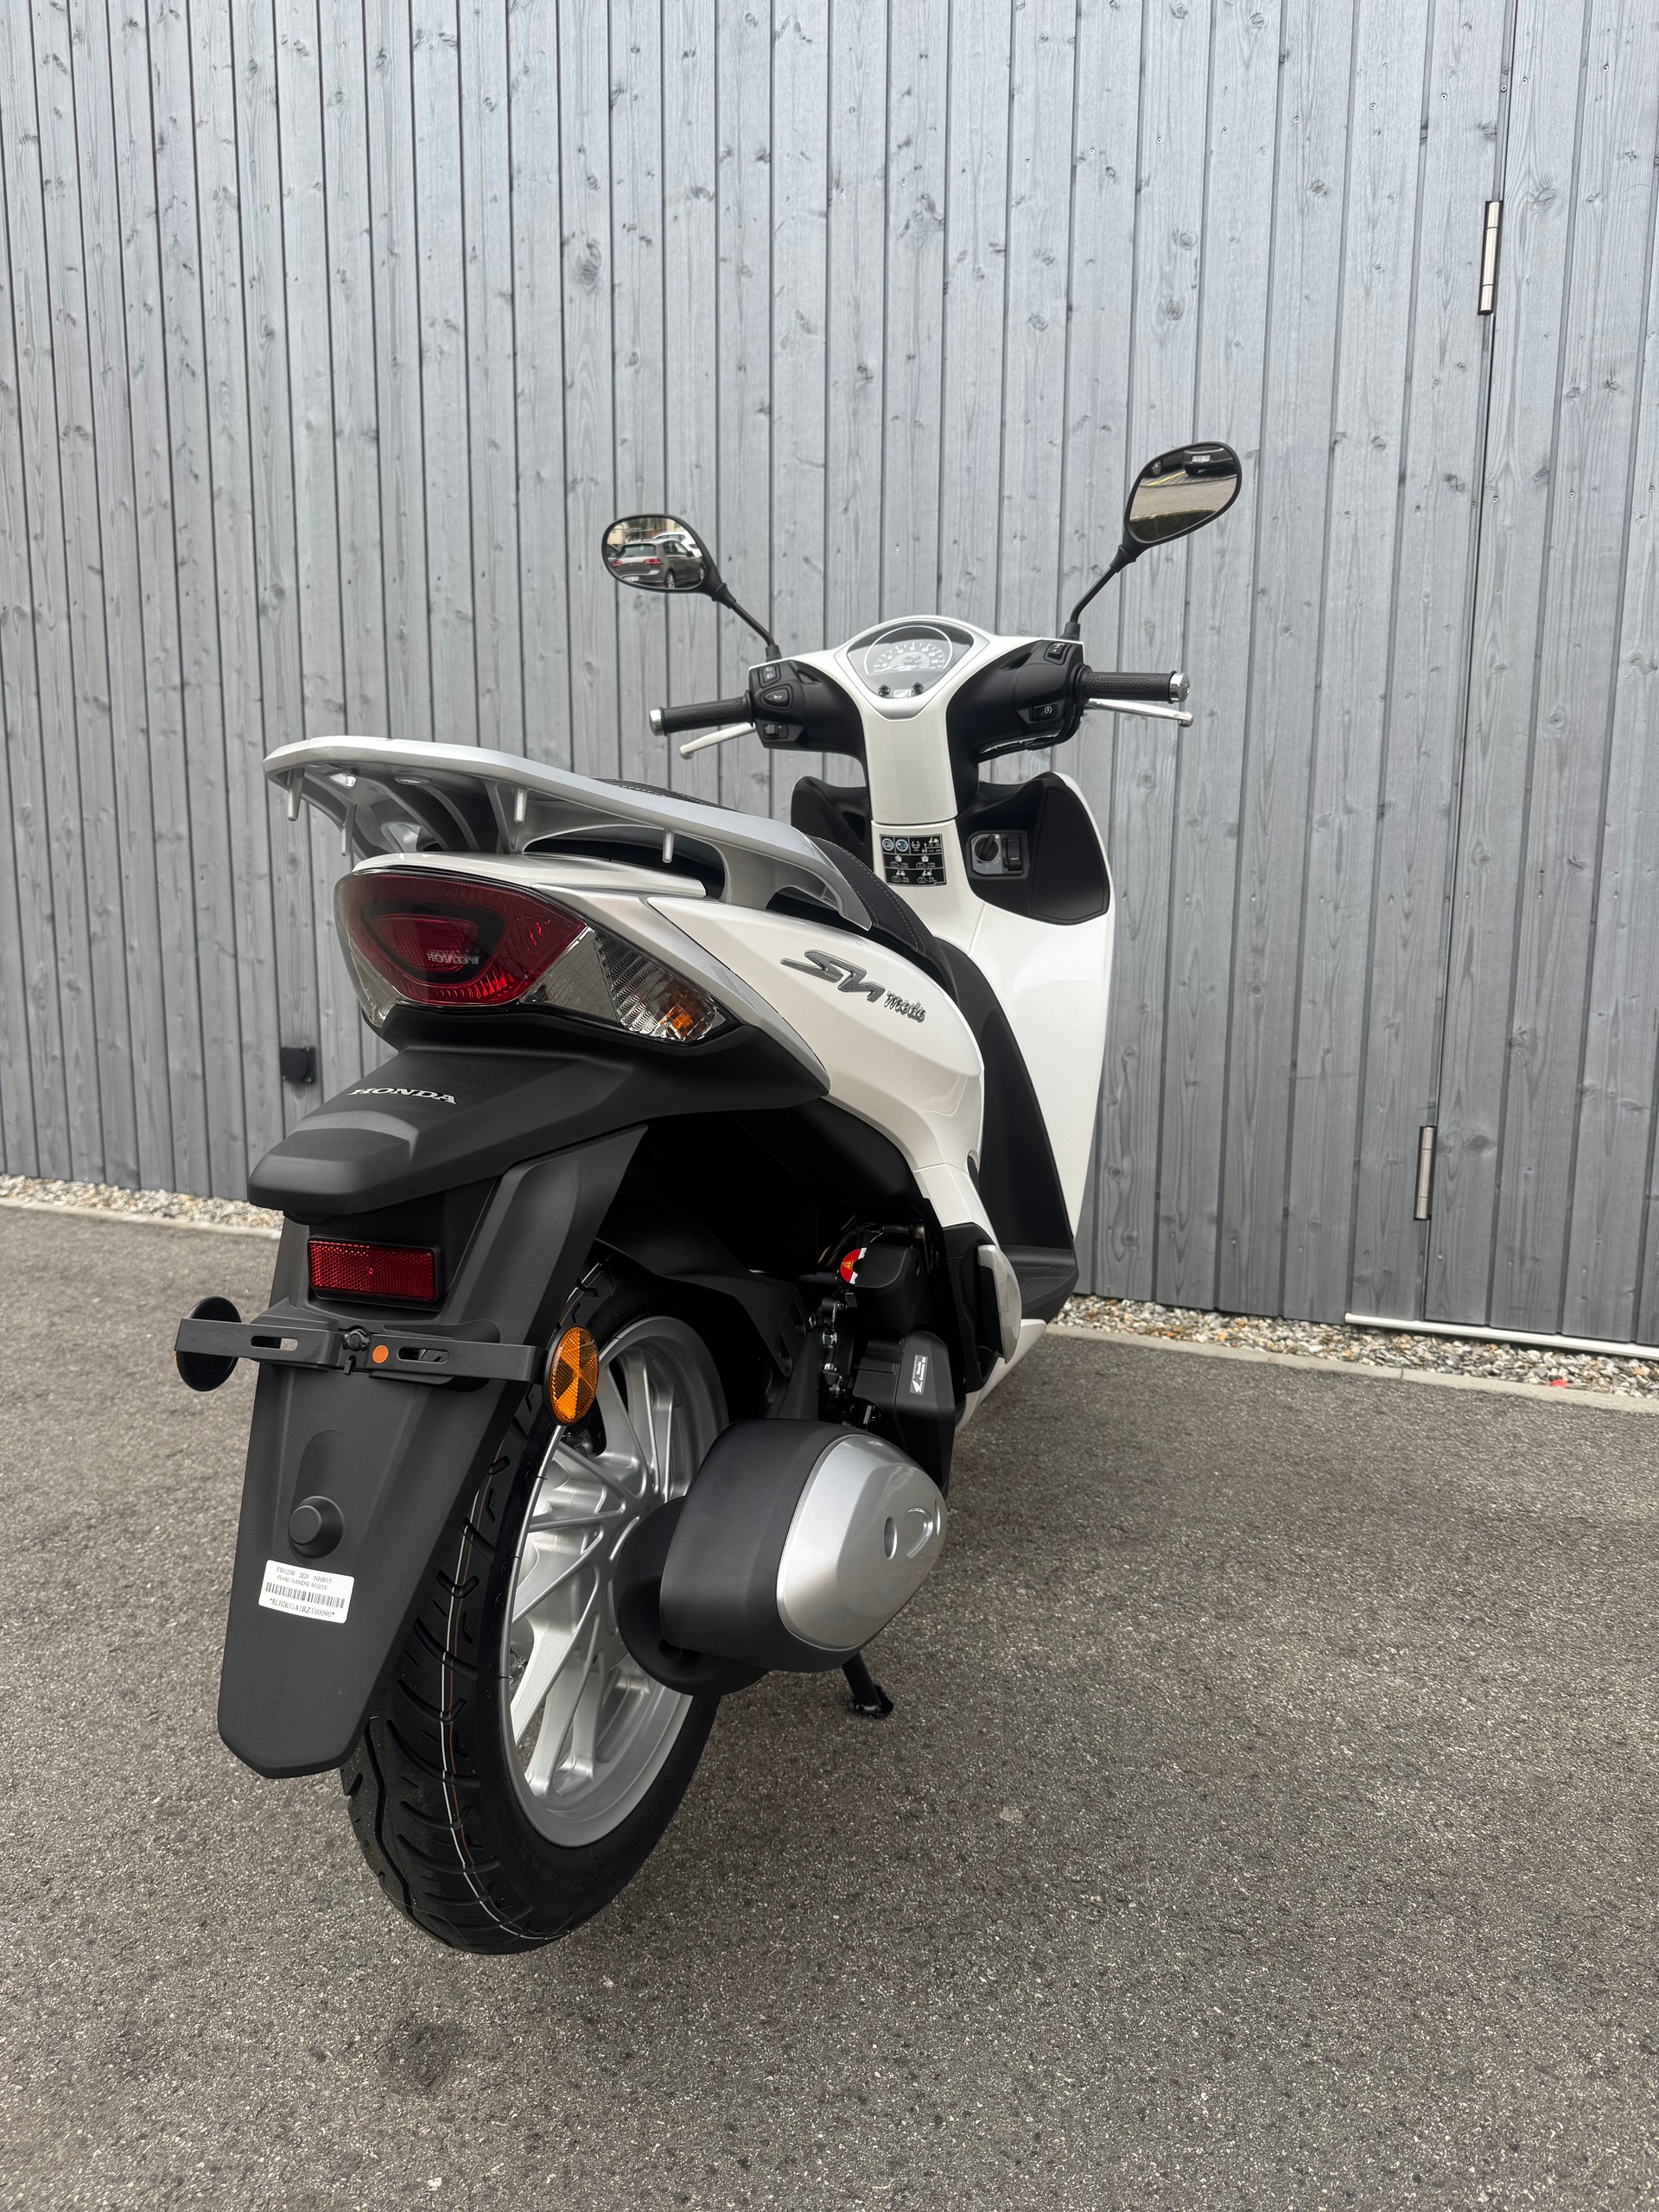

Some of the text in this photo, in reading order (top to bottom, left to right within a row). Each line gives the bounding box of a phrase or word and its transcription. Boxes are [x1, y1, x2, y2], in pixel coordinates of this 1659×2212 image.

[884, 991, 925, 1023] mode
[347, 1088, 456, 1104] HONDA
[276, 1574, 289, 1583] PEARL
